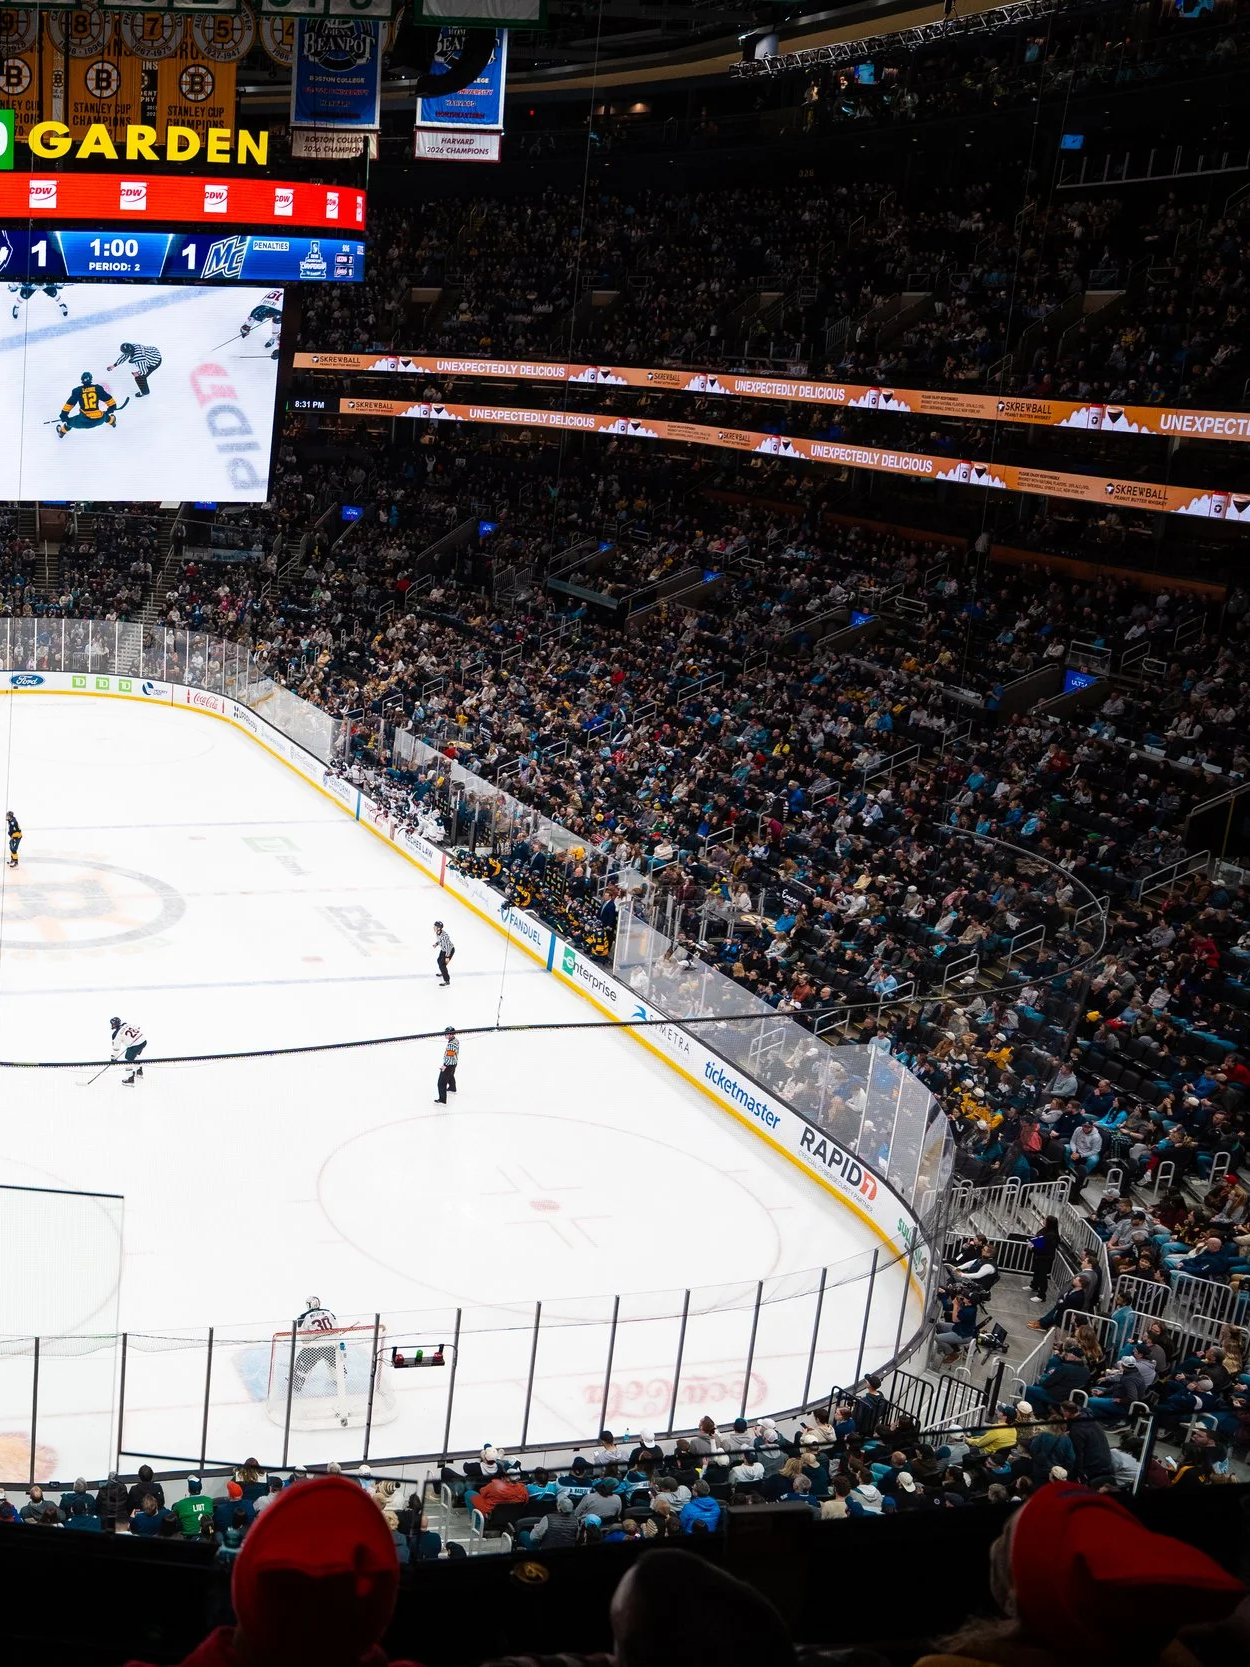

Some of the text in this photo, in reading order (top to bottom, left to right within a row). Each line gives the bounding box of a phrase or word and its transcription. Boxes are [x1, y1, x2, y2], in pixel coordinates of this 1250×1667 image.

[74, 15, 87, 34] 8
[149, 17, 160, 35] 7
[216, 20, 229, 38] 5
[303, 32, 376, 63] BEANPOT
[74, 103, 132, 115] STANLEY CUP
[167, 105, 207, 117] STANLEY
[208, 107, 224, 118] CUP
[73, 115, 132, 127] CHAMPIONS
[166, 118, 224, 129] CHAMPIONS
[28, 121, 269, 166] GARDEN
[305, 136, 330, 144] BOSTON
[440, 137, 475, 146] HARVARD
[303, 145, 364, 155] 2026 CHAMPION
[426, 146, 490, 157] 2026 CHAMPIONS
[90, 238, 138, 257] 1:00
[253, 241, 288, 250] PENALTIES
[31, 240, 47, 267] 1
[182, 243, 196, 270] 1
[89, 262, 131, 271] PERIOD:
[320, 356, 361, 364] SKREWBALL
[436, 361, 565, 378] UNEXPECTEDLY DELICIOUS
[734, 379, 845, 401] UNEXPECTEDLY DELICIOUS
[81, 391, 97, 410] 12
[295, 401, 325, 409] 8:31 PM
[356, 402, 394, 410] SKREWBALL
[1006, 401, 1052, 415] SKREWBALL
[469, 408, 595, 428] UNEXPECTEDLY DELICIOUS
[811, 444, 932, 473] UNEXPECTEDLY DELICIOUS
[1115, 484, 1168, 500] SKREWBALL
[14, 675, 40, 686] Ford
[74, 677, 85, 687] TD
[98, 679, 109, 689] TD
[120, 681, 132, 691] TD
[193, 692, 219, 710] Coca-Cola
[421, 845, 434, 859] LAW
[510, 913, 542, 946] FANDUEL
[563, 955, 618, 1002] enterprise
[704, 1060, 781, 1130] ticketmaster
[799, 1126, 878, 1201] RAPID7
[816, 1164, 854, 1198] CYBERSECURITY
[852, 1193, 874, 1213] PARTNER
[312, 1317, 333, 1331] 30
